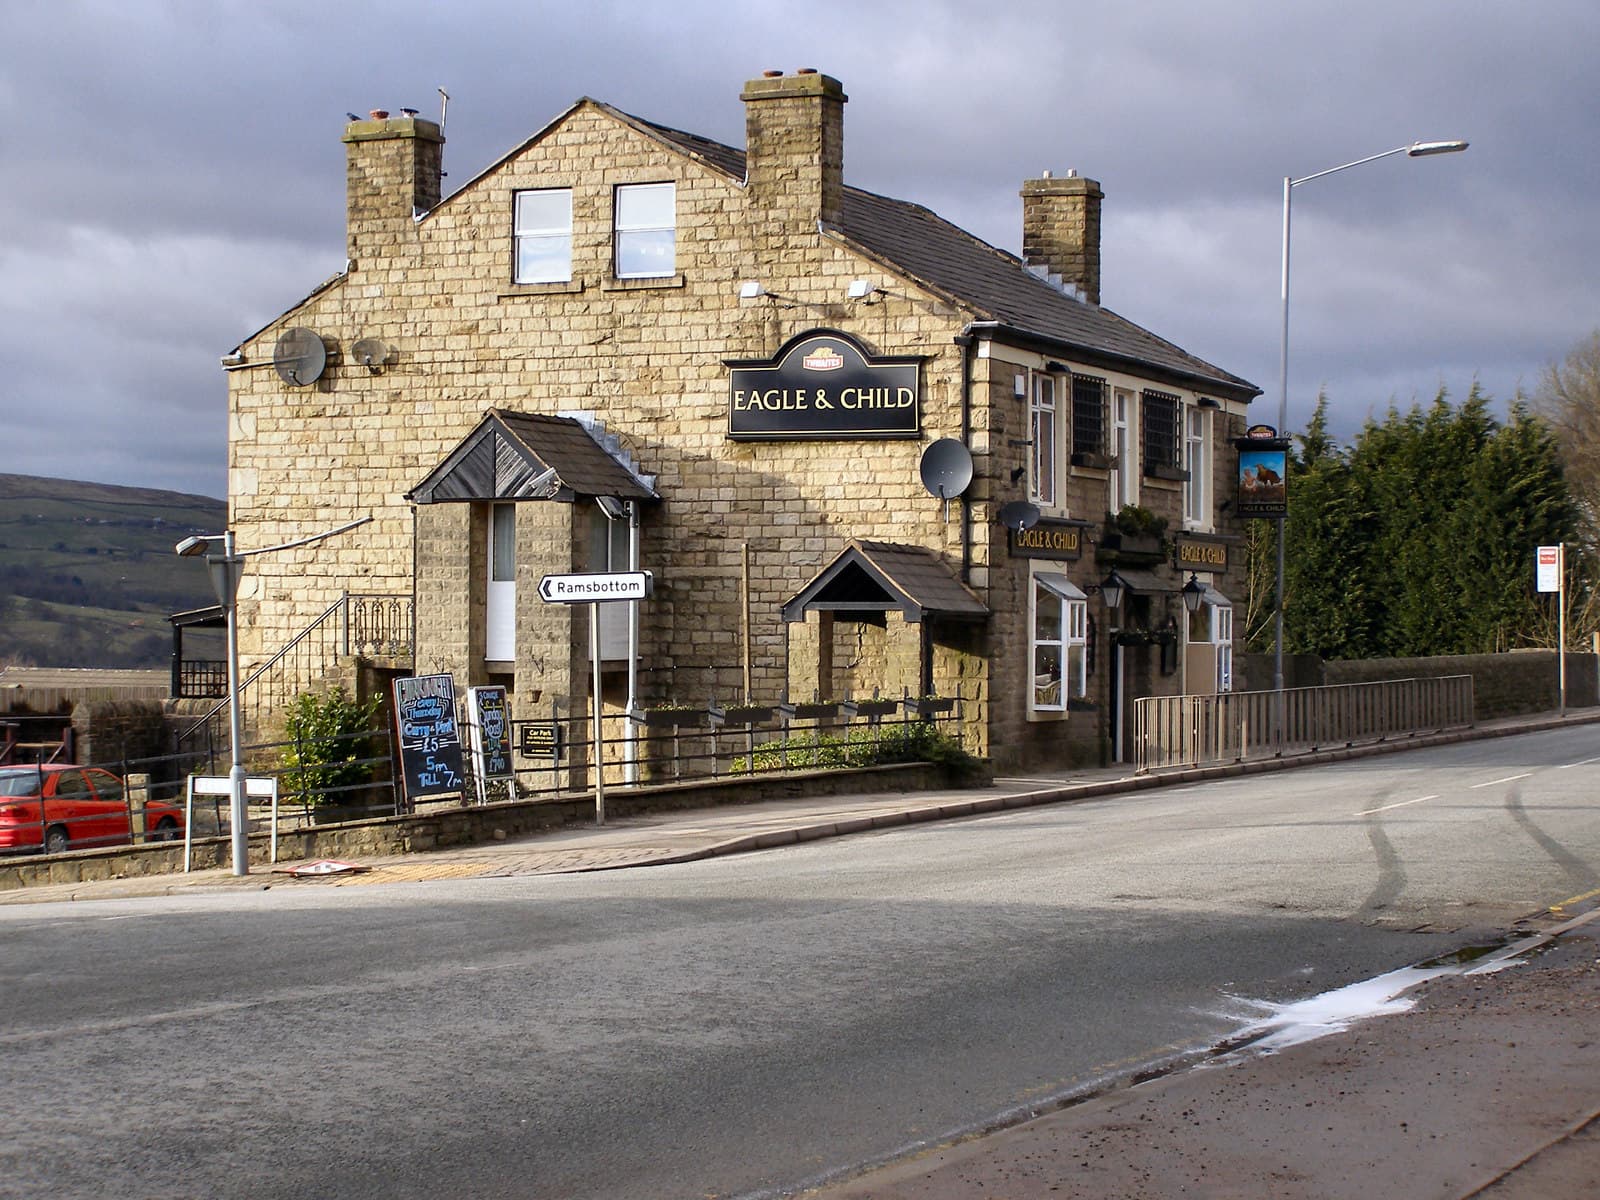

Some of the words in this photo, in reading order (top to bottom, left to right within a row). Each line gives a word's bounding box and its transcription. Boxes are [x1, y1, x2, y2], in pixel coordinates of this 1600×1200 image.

[734, 389, 808, 411] EAGLE
[814, 388, 834, 410] &
[840, 387, 914, 409] CHILD
[1018, 529, 1044, 548] EAGLE
[1045, 531, 1053, 548] &
[1053, 532, 1078, 550] CHILD
[1181, 545, 1200, 561] EAGLE
[1207, 547, 1225, 564] CHILD
[557, 580, 640, 593] Ramsbottom
[423, 737, 438, 752] £5
